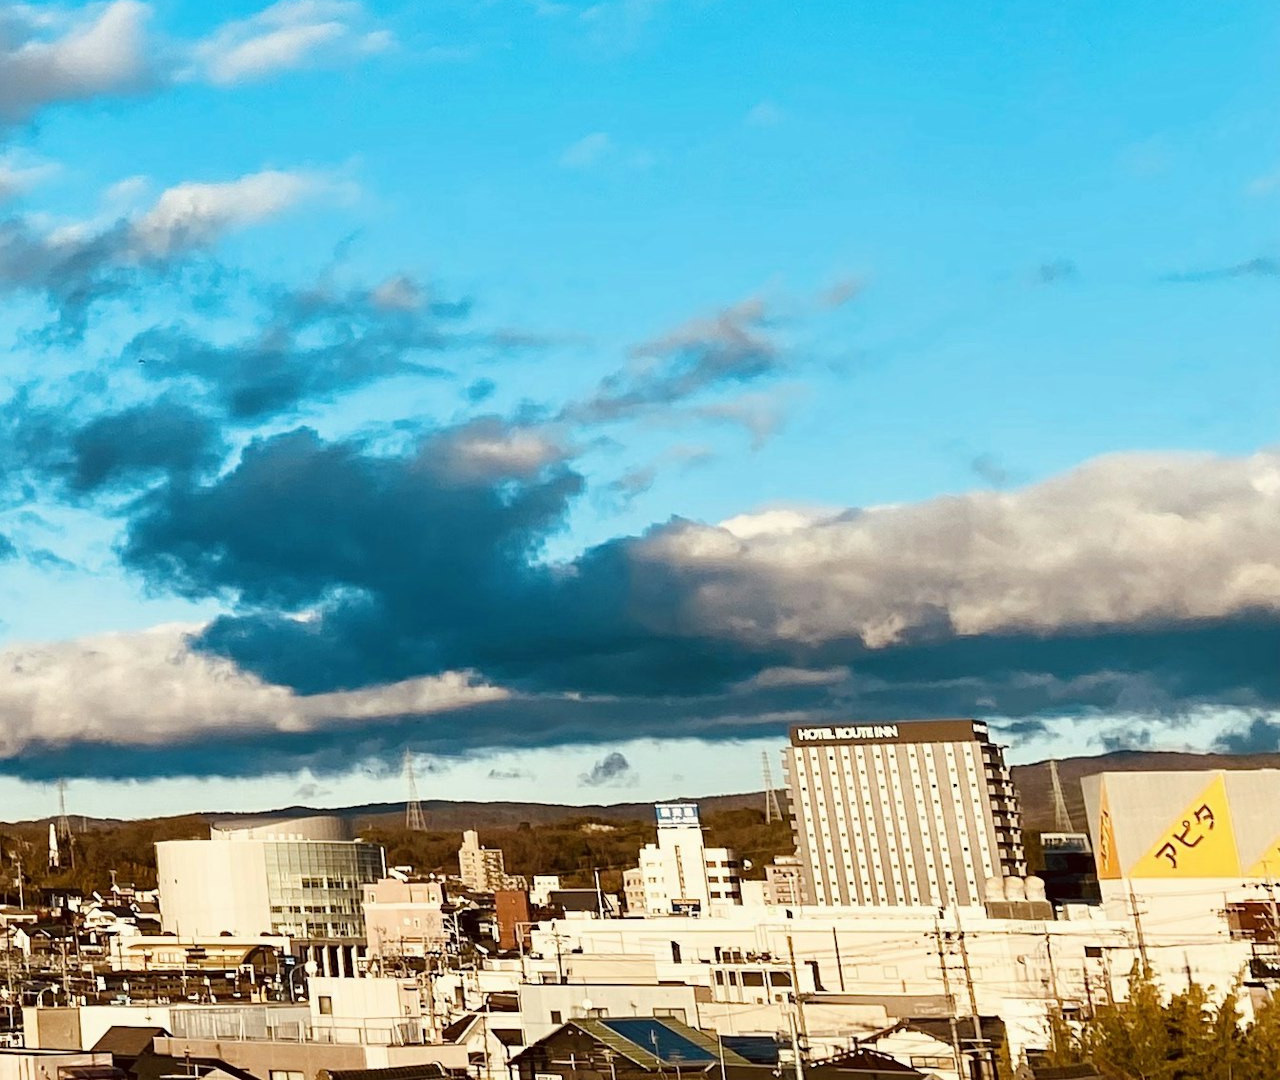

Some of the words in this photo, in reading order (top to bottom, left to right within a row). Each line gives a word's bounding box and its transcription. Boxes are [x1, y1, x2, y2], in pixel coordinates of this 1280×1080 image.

[798, 728, 835, 741] HOTEL
[835, 726, 874, 740] ROUTE
[874, 724, 898, 738] INN
[1154, 803, 1215, 869] アピタ
